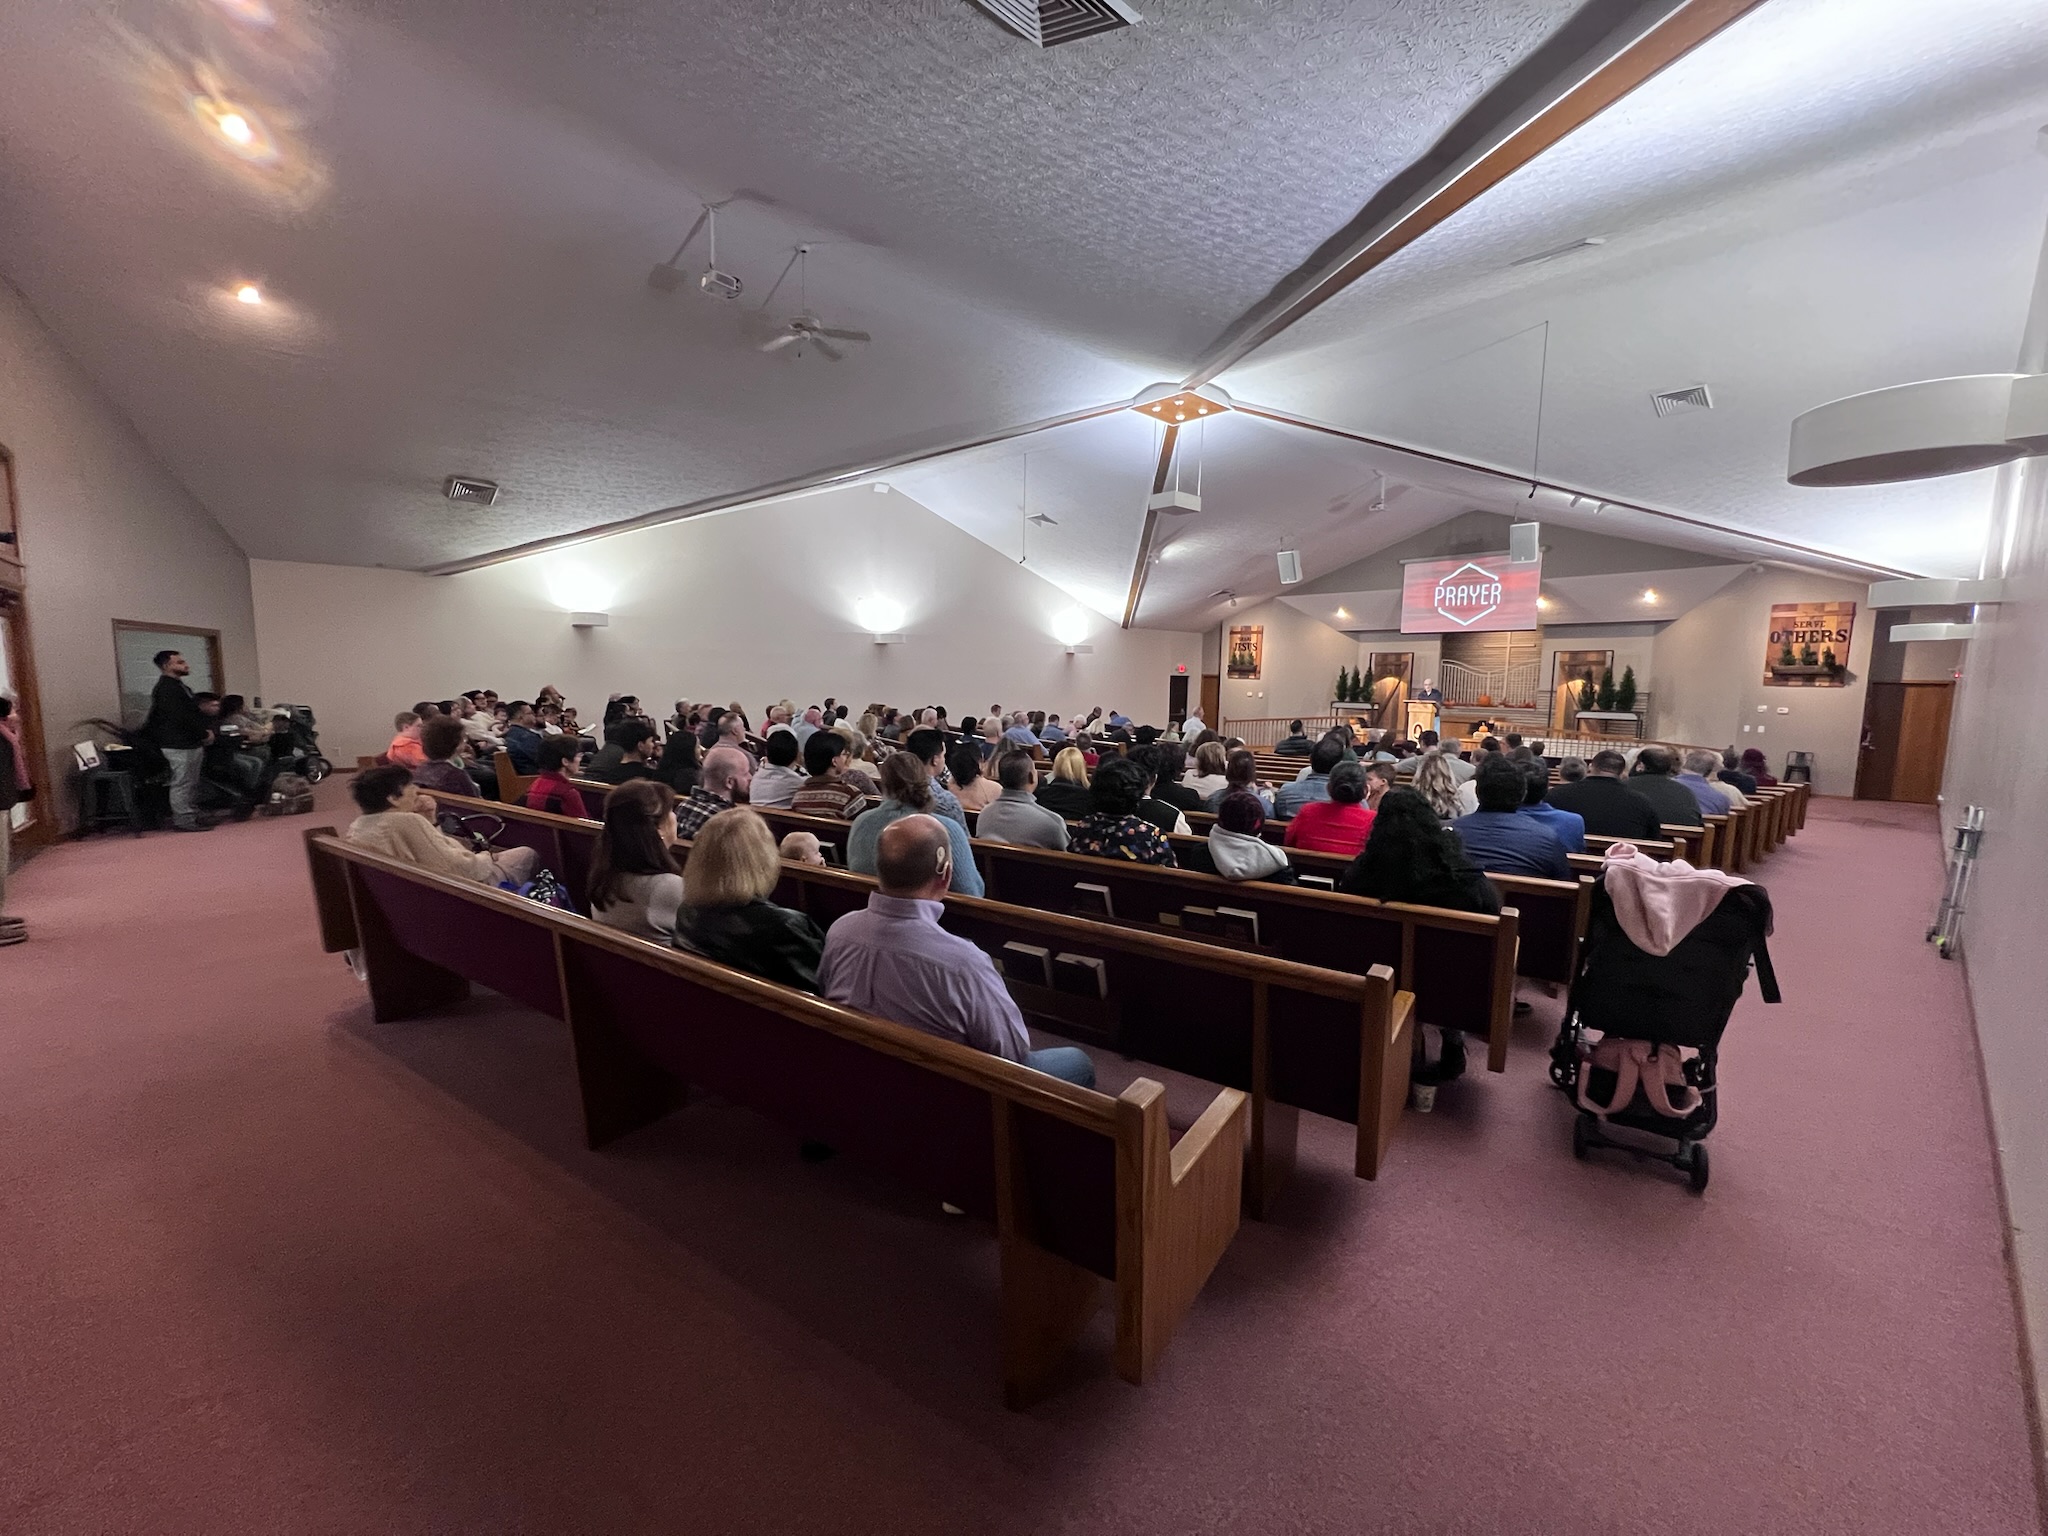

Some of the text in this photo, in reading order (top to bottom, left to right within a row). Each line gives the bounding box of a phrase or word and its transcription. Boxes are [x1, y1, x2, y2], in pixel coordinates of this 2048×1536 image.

[1434, 583, 1501, 607] PRAYER
[1770, 629, 1848, 644] OTHERS
[1234, 643, 1257, 651] JESUS
